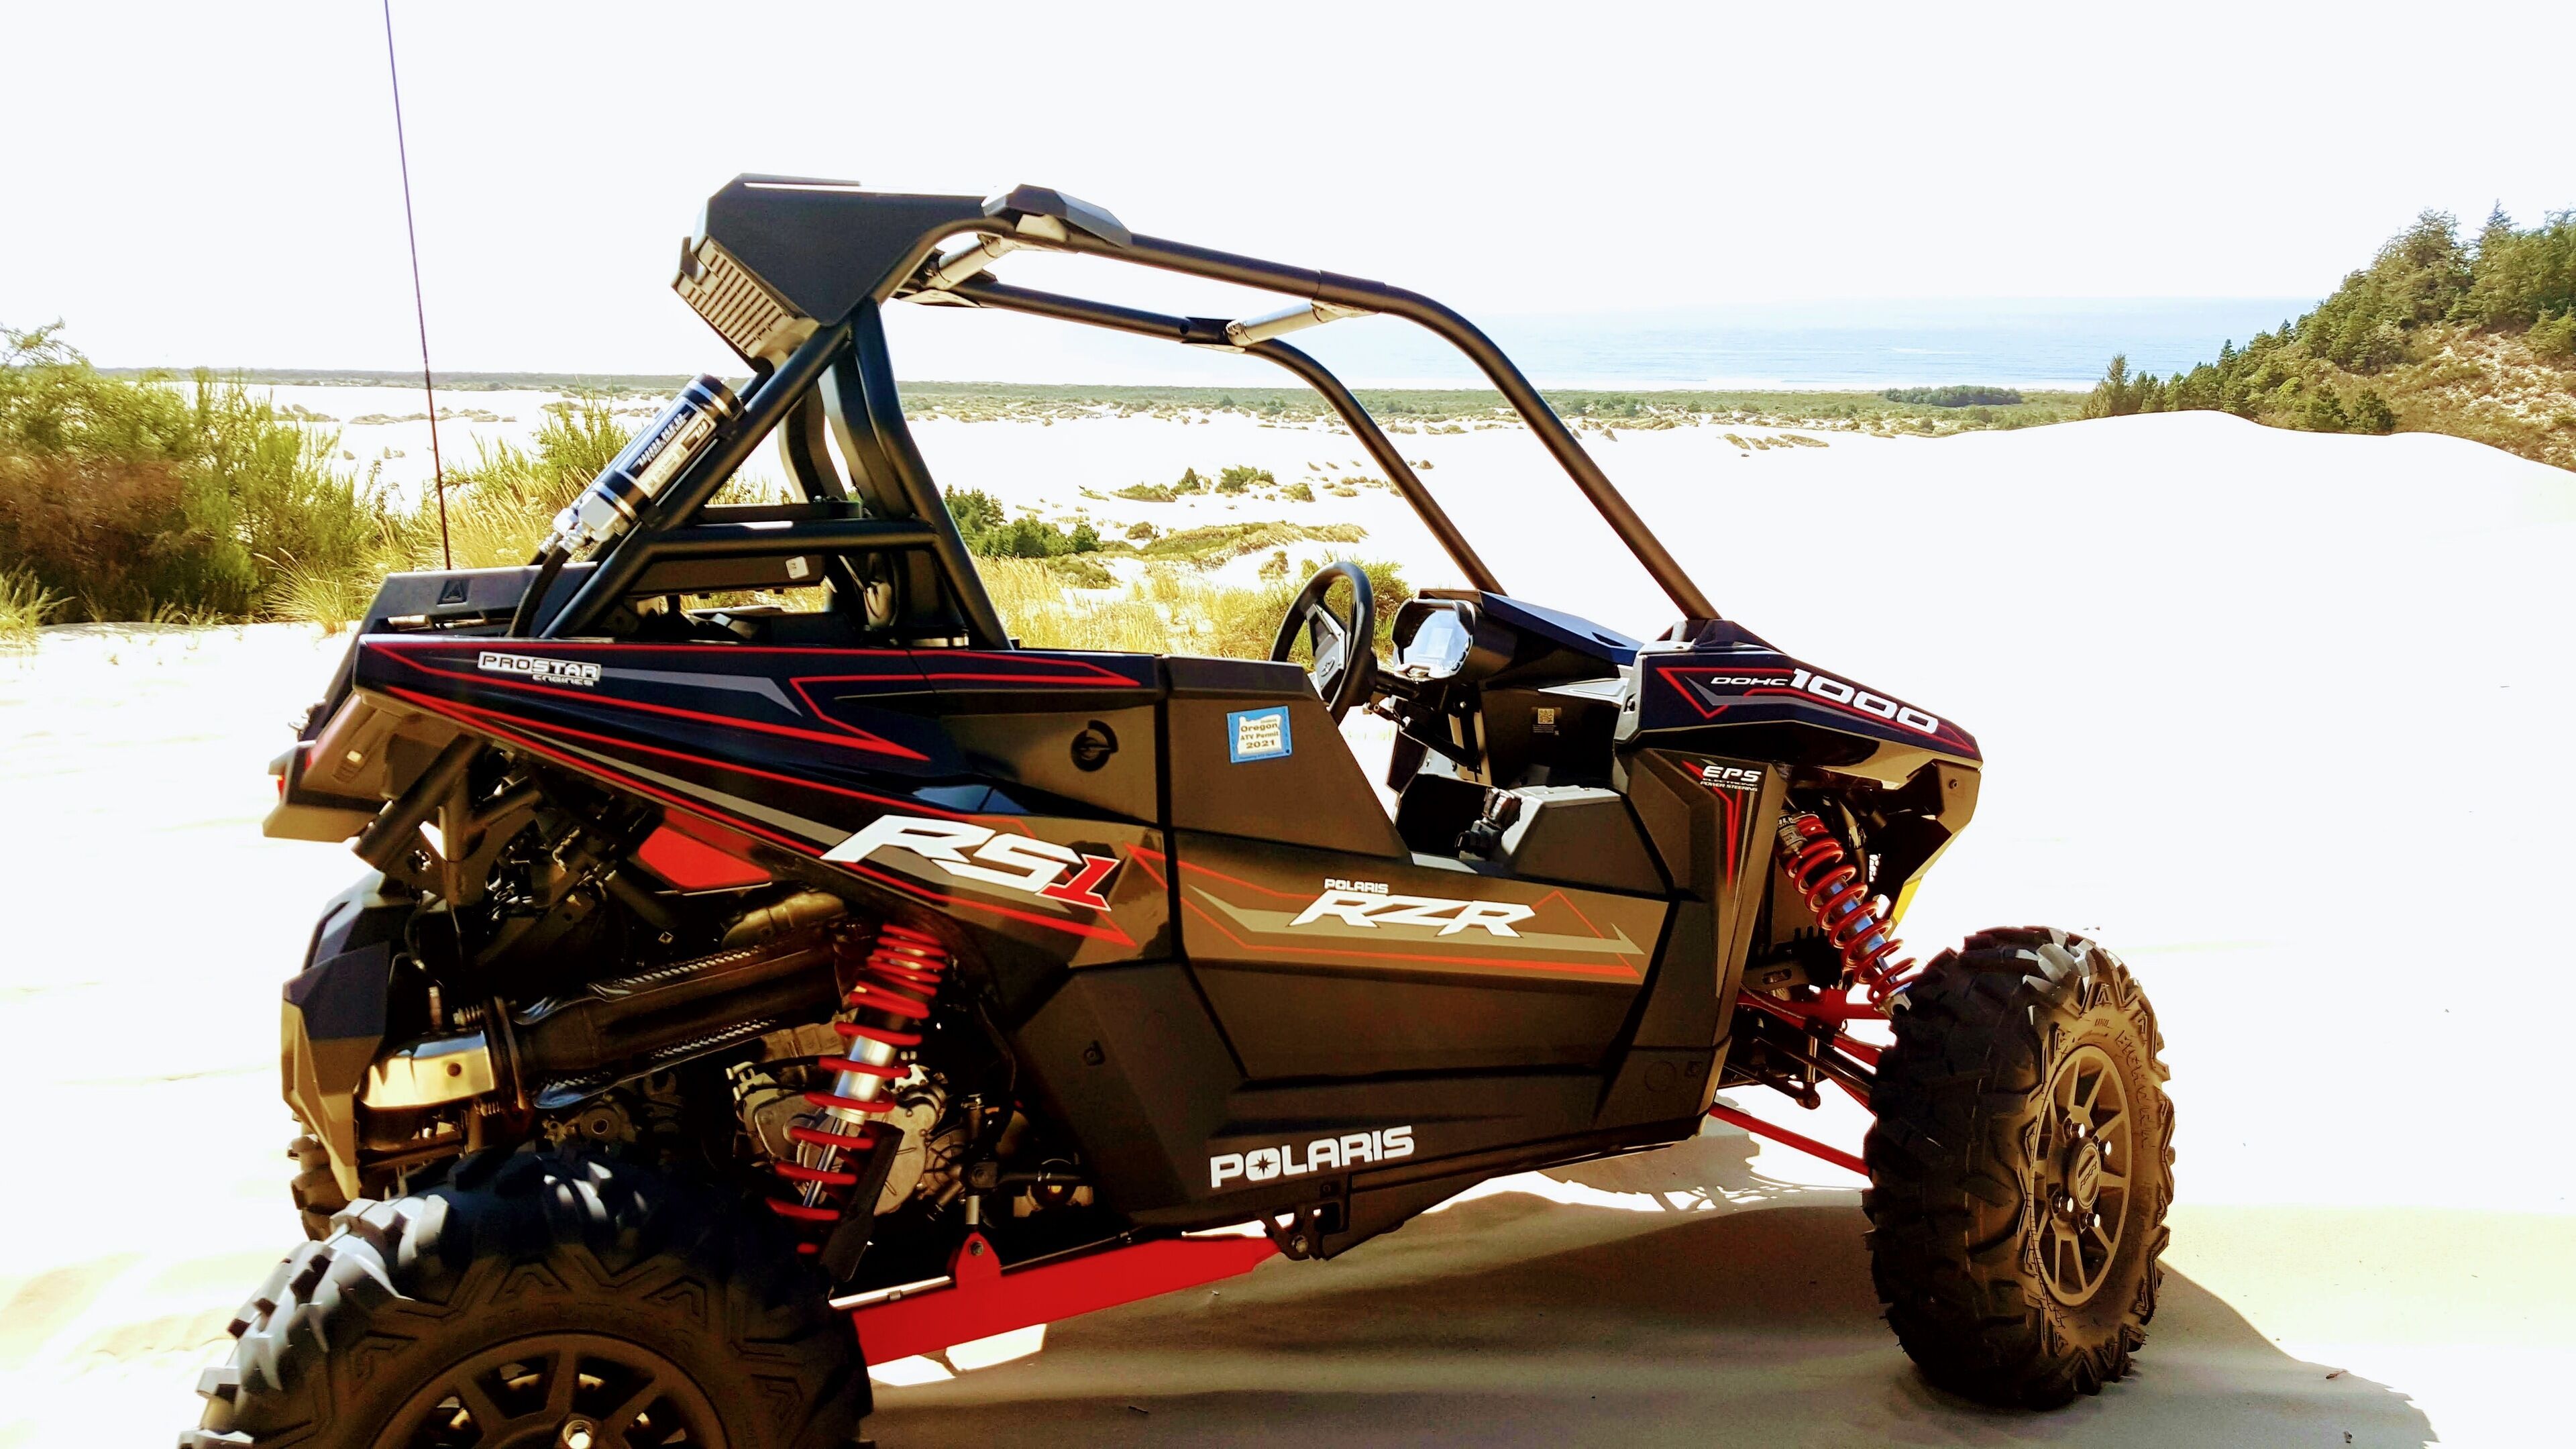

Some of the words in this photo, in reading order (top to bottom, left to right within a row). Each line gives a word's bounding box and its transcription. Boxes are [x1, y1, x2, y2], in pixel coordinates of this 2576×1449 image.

[479, 652, 600, 681] PROSTAR
[1711, 676, 1788, 686] DOHC
[1790, 668, 1939, 735] 1000
[1240, 722, 1278, 732] Oregon
[1240, 733, 1254, 741] ATV
[1256, 731, 1279, 739] Permit
[1246, 739, 1275, 749] 2021
[1703, 765, 1762, 782] EPS
[1324, 878, 1389, 894] POLARIS
[1287, 889, 1536, 938] RZR
[1210, 1125, 1415, 1188] POLARIS
